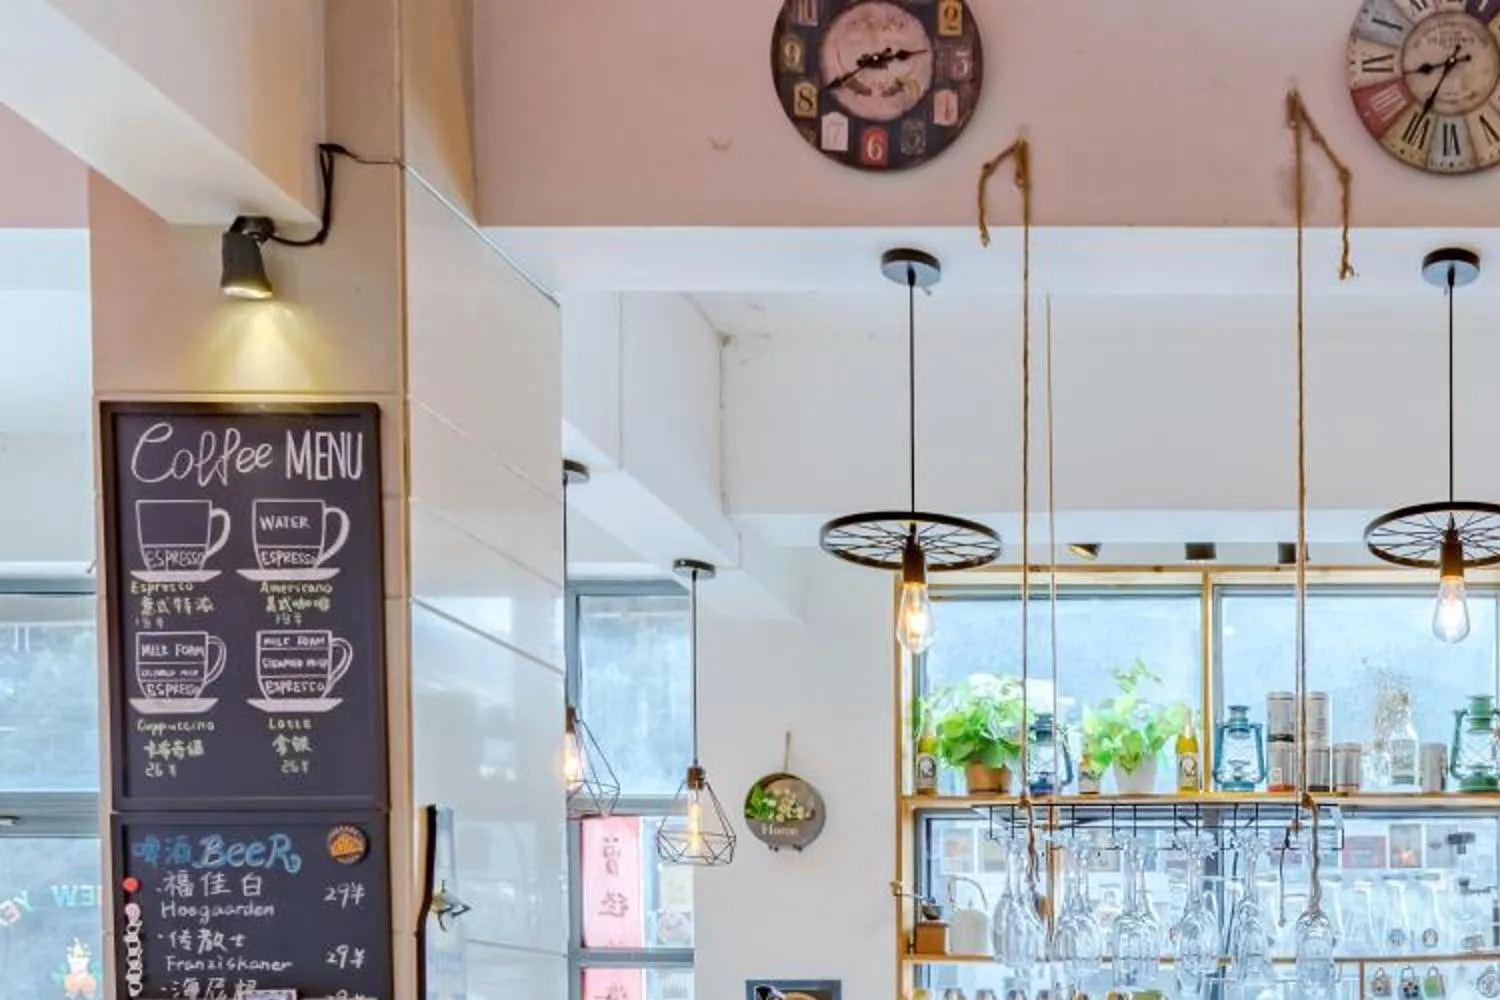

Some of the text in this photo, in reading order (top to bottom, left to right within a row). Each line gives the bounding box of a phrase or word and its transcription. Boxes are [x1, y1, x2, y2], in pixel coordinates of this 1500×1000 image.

[866, 134, 883, 161] 6
[131, 422, 363, 487] Coffee MENU
[260, 515, 311, 530] WATER
[761, 823, 799, 836] Home
[163, 869, 262, 898] 福佳白
[166, 954, 293, 972] Franziskaner
